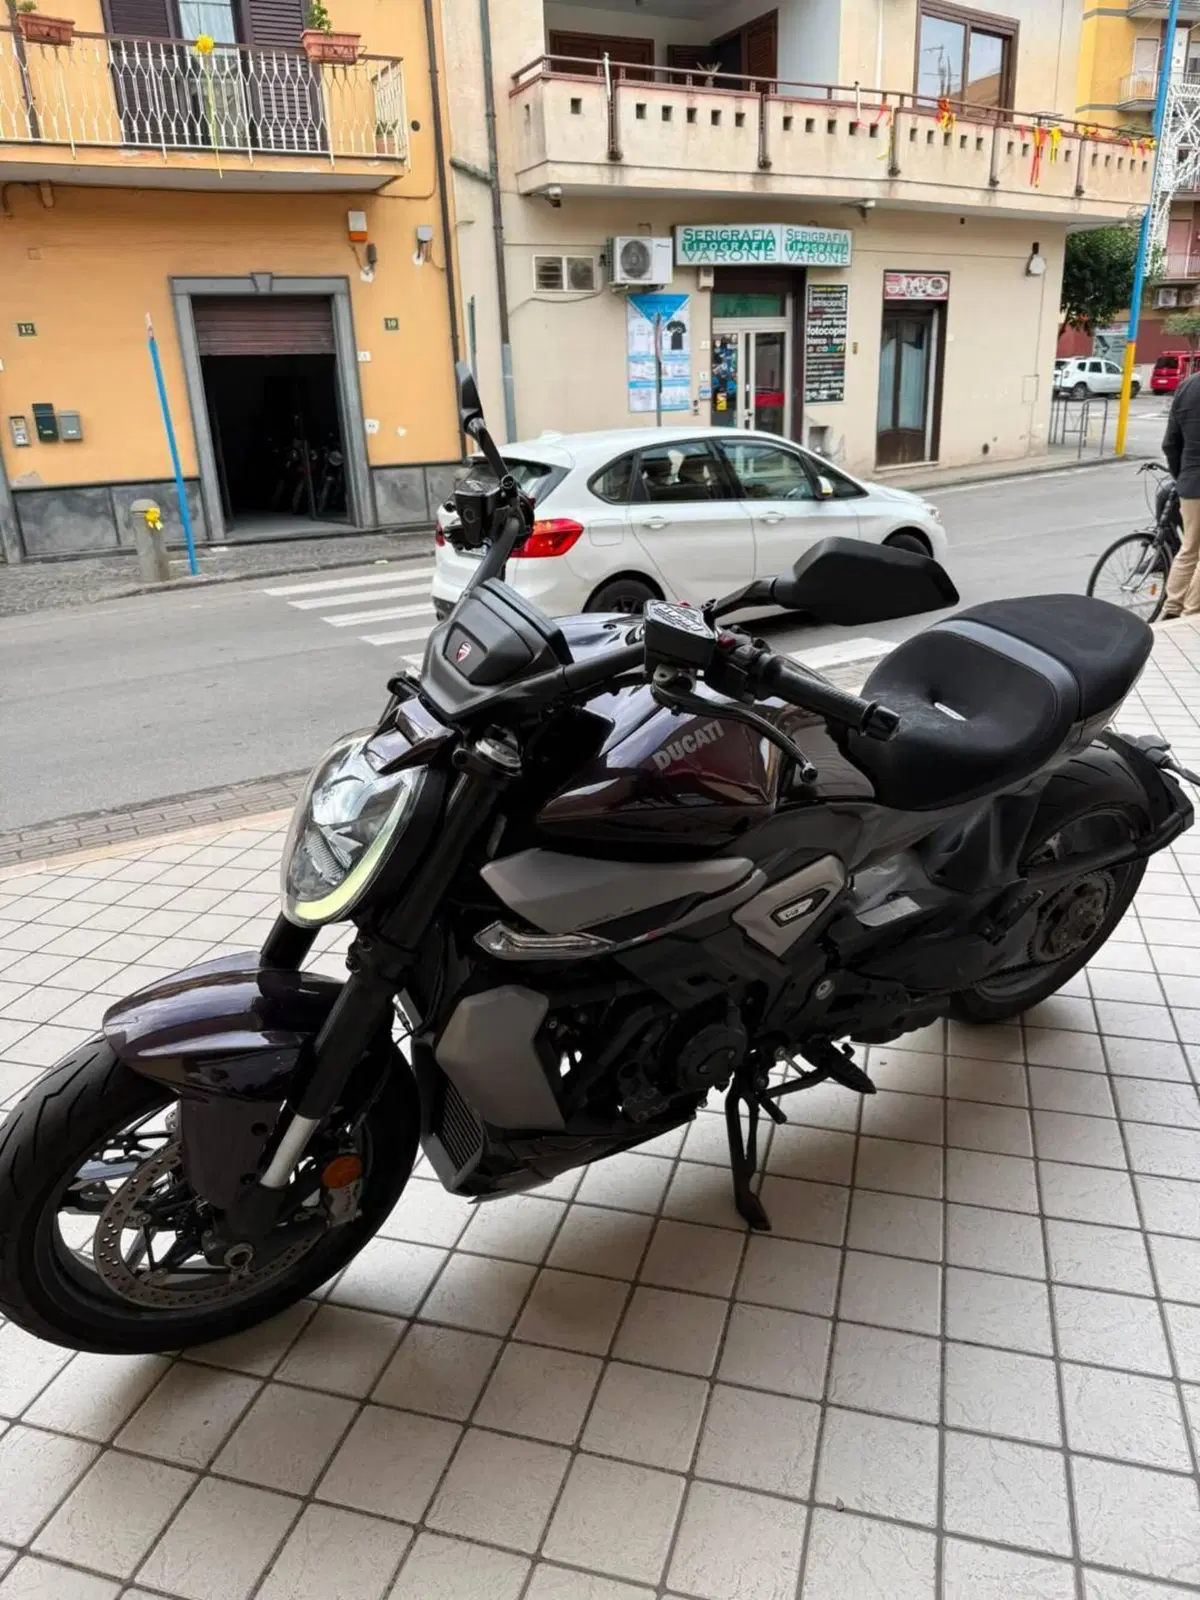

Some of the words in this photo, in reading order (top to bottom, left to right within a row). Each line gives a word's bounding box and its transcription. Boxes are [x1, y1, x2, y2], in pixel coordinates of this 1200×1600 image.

[683, 228, 775, 241] SERIGRAFIA
[786, 228, 849, 243] SERIGRAFIA
[683, 241, 775, 251] TIPOGRAFIA
[683, 251, 777, 262] VARONE
[786, 251, 848, 264] VARONE
[20, 325, 34, 334] 12
[652, 720, 724, 770] DUCATI
